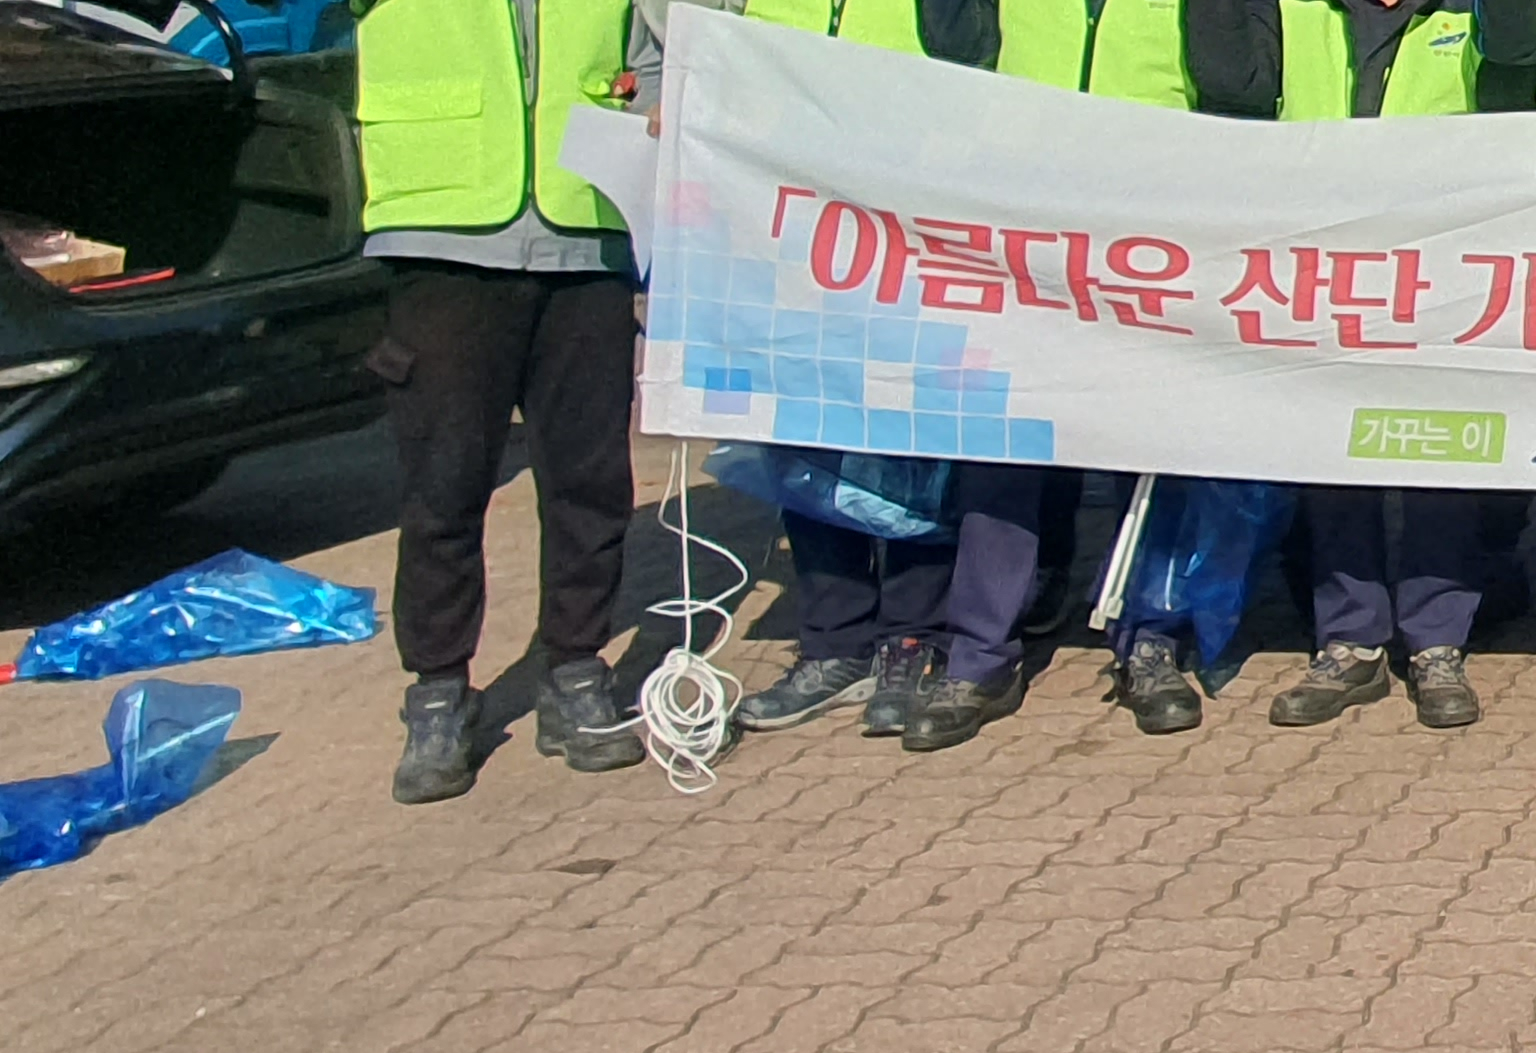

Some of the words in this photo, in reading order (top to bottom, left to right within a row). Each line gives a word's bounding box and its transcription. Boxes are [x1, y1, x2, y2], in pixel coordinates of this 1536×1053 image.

[1220, 246, 1430, 350] 산단
[1358, 415, 1452, 456] 가꾸는
[1461, 420, 1493, 458] 이
